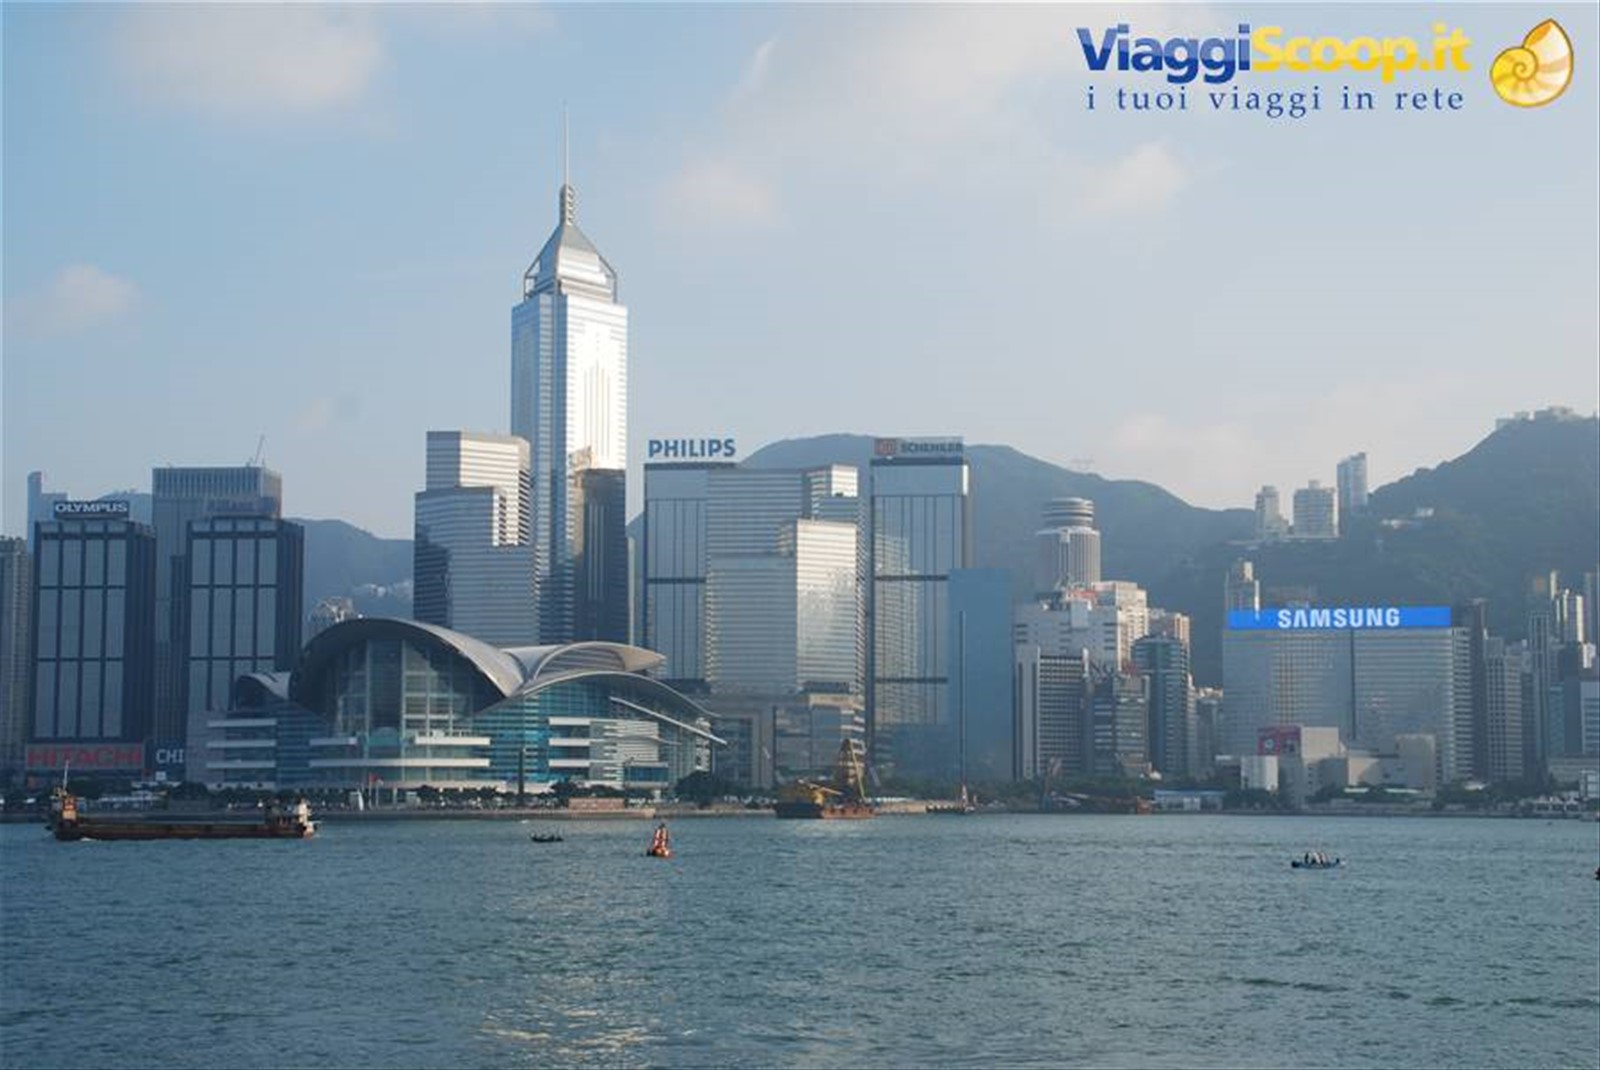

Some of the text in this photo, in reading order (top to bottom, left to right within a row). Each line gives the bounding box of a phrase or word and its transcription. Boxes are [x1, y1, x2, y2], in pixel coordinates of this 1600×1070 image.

[648, 439, 736, 457] PHILIPS
[55, 502, 129, 513] OLYMPUS
[1277, 607, 1400, 628] SAMSUNG
[27, 744, 142, 767] HITACHI
